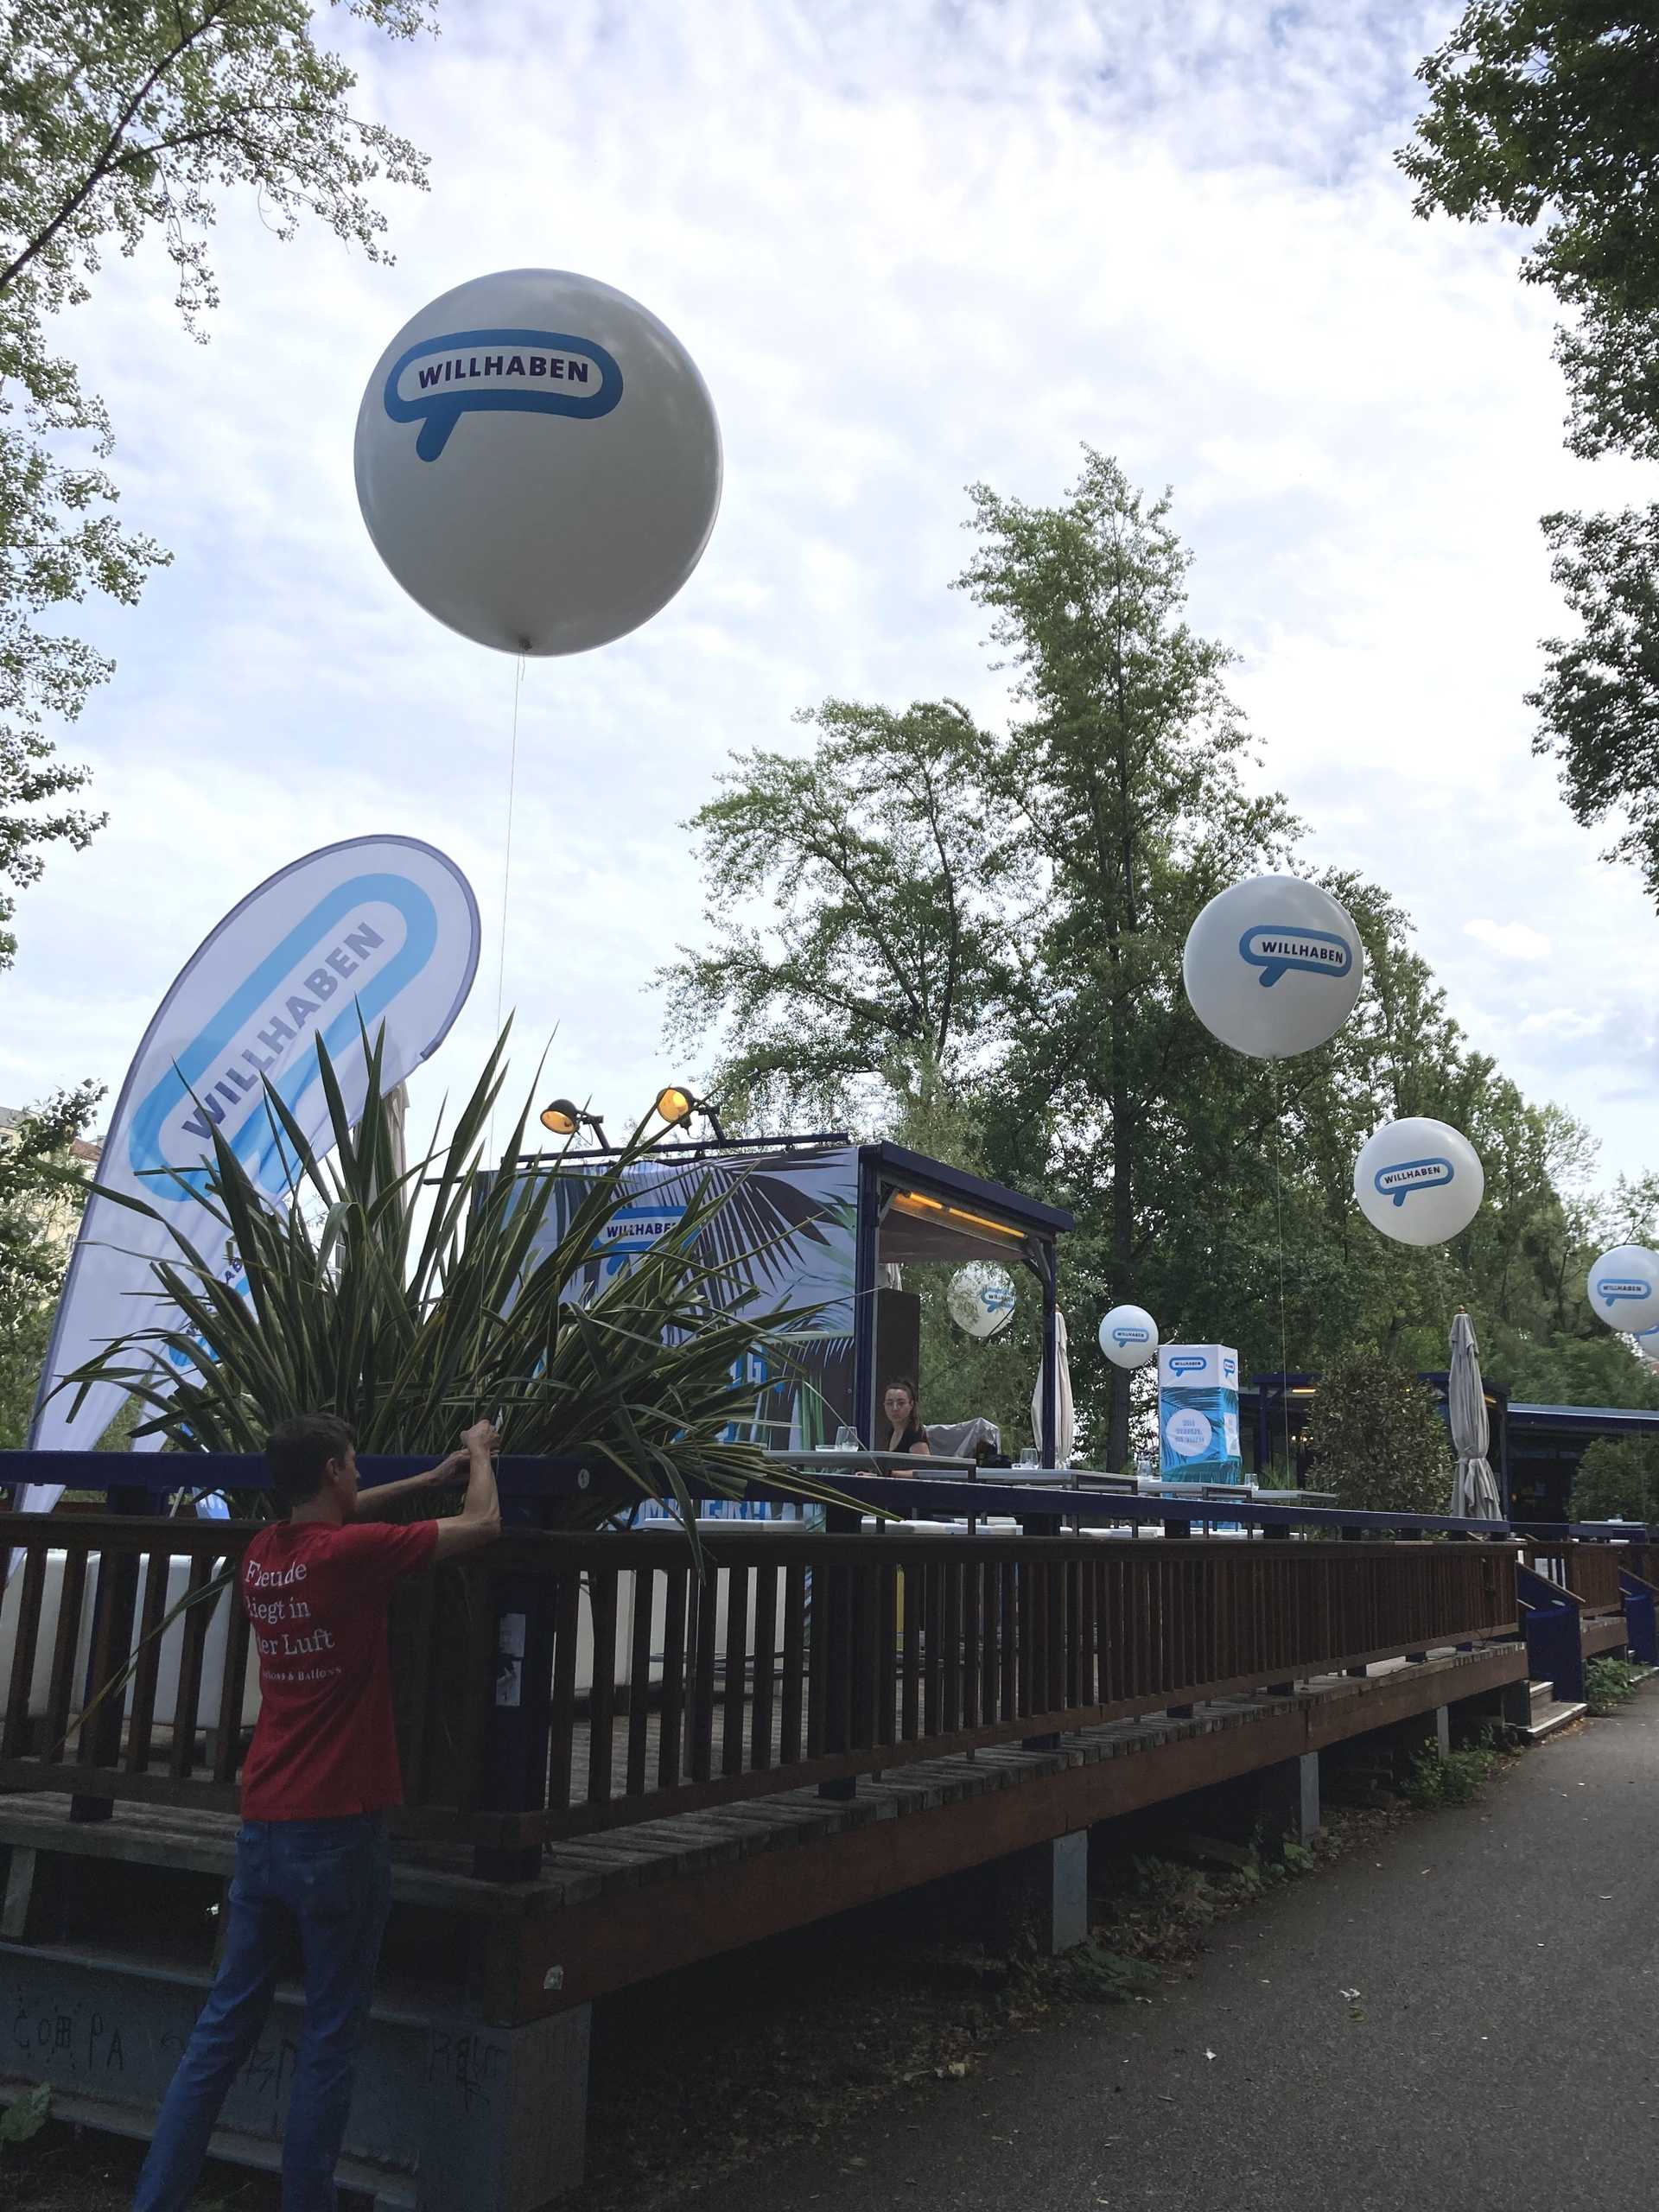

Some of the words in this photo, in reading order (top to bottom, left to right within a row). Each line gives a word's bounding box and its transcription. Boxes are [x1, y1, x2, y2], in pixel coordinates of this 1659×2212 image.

[418, 355, 589, 389] WILLHABEN
[1262, 941, 1344, 964] WILLHABEN
[181, 921, 385, 1141] WILLHABEN
[1383, 1166, 1441, 1185] WILLHABEN
[607, 1222, 678, 1238] WILLHABE
[289, 1597, 311, 1618] in
[283, 1628, 335, 1656] Luft
